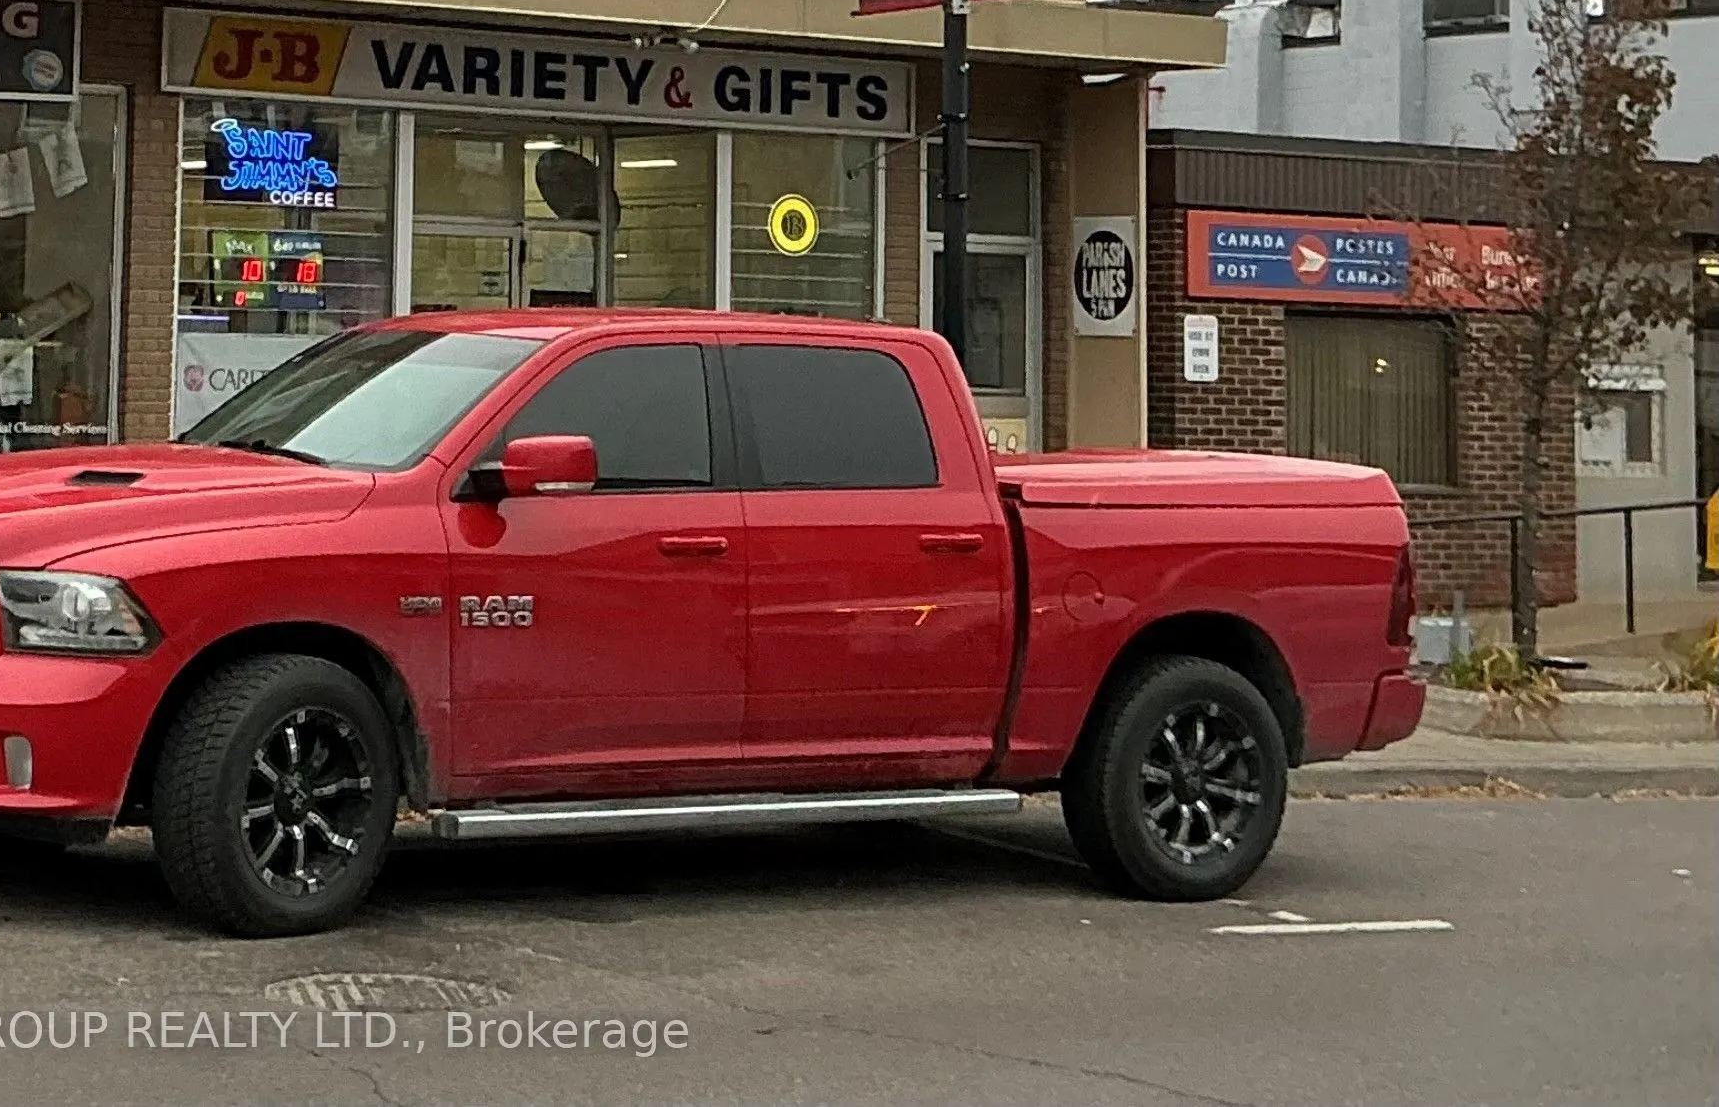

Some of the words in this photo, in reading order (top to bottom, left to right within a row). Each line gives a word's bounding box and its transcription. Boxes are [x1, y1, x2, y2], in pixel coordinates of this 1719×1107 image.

[371, 40, 654, 107] VARIETY
[663, 65, 694, 110] &
[713, 65, 888, 122] GIFTS
[222, 126, 312, 160] SAINT
[270, 190, 335, 208] COFFEE
[1216, 232, 1286, 249] CANADA
[242, 260, 261, 281] 10
[297, 262, 316, 283] 18
[1216, 263, 1258, 280] POST
[1082, 268, 1127, 299] LANES
[14, 421, 61, 436] Cleaning
[62, 422, 107, 435] Services
[460, 595, 534, 611] RAM
[460, 611, 533, 627] 1500
